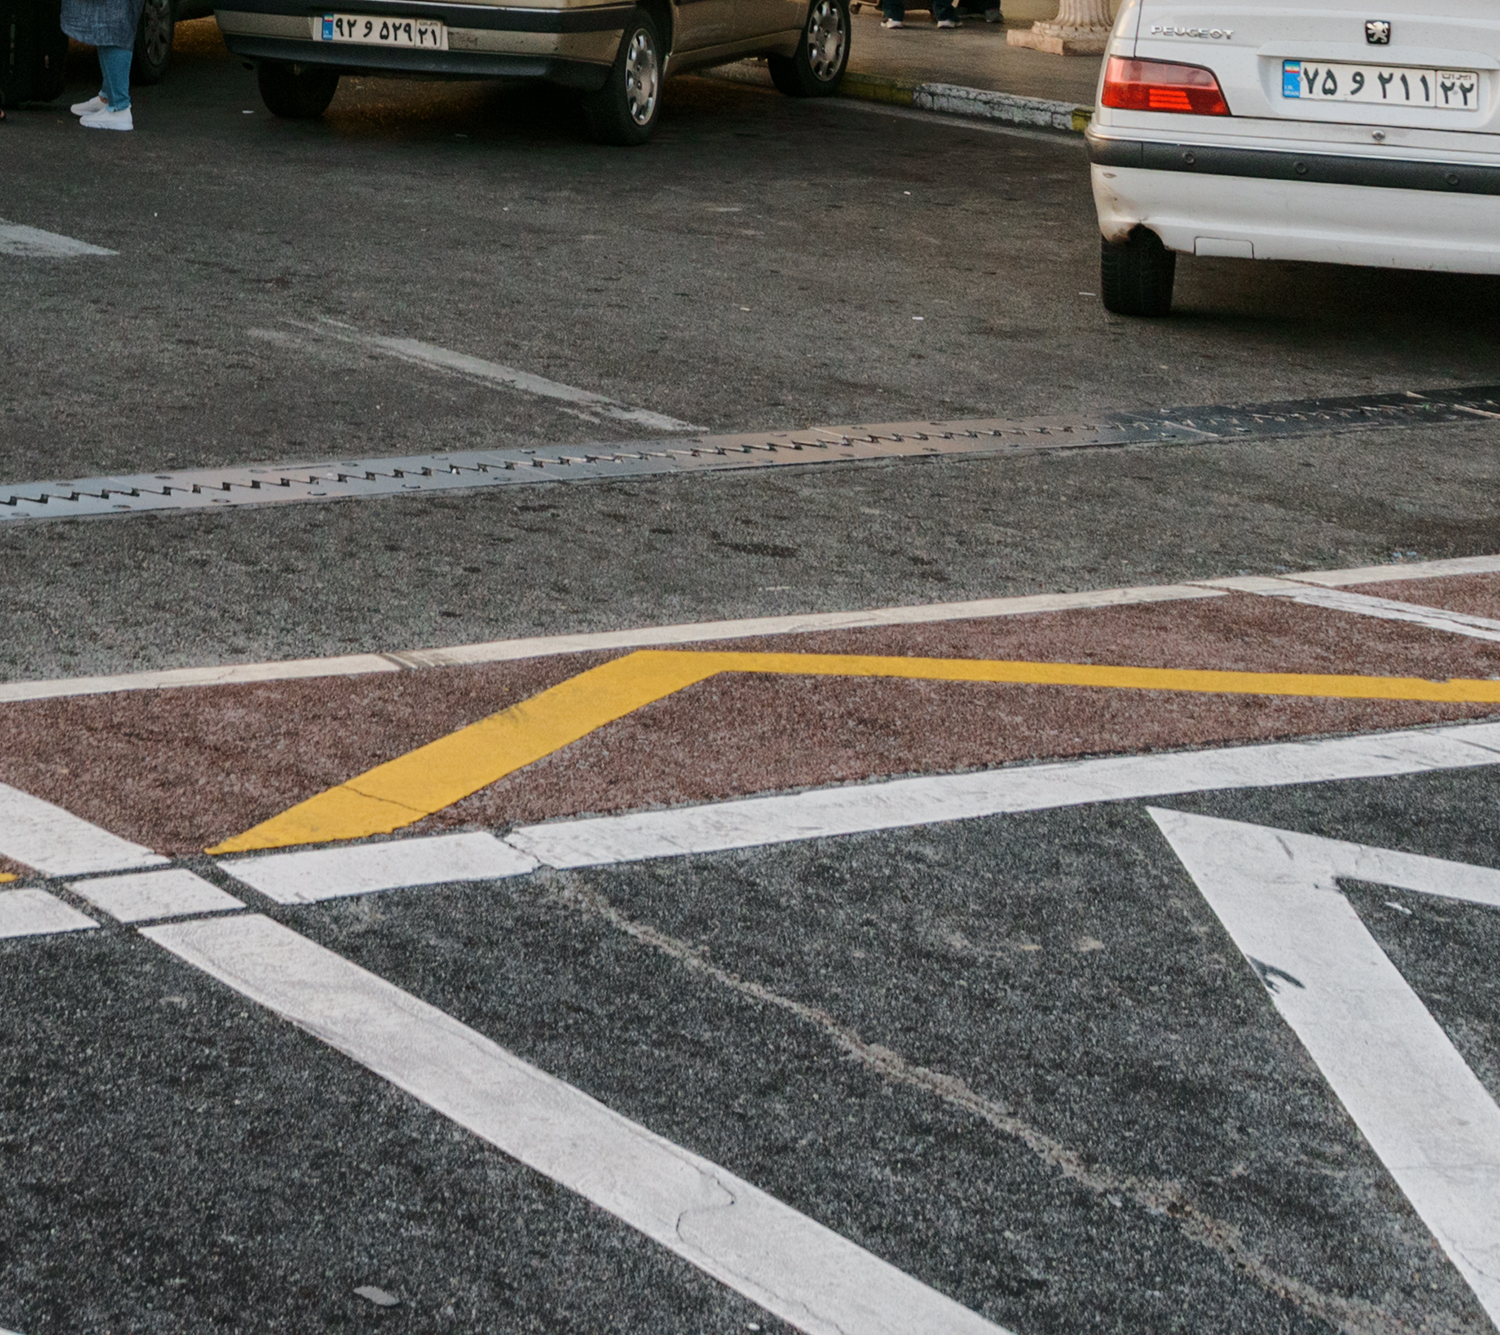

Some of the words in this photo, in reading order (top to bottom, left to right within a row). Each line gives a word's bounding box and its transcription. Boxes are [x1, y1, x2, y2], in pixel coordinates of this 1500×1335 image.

[1151, 25, 1235, 40] PEUGEOT
[1303, 67, 1338, 96] ۷۵
[1350, 71, 1365, 96] و
[1378, 71, 1430, 101] ۲۱۱
[1440, 80, 1474, 106] ۲۲
